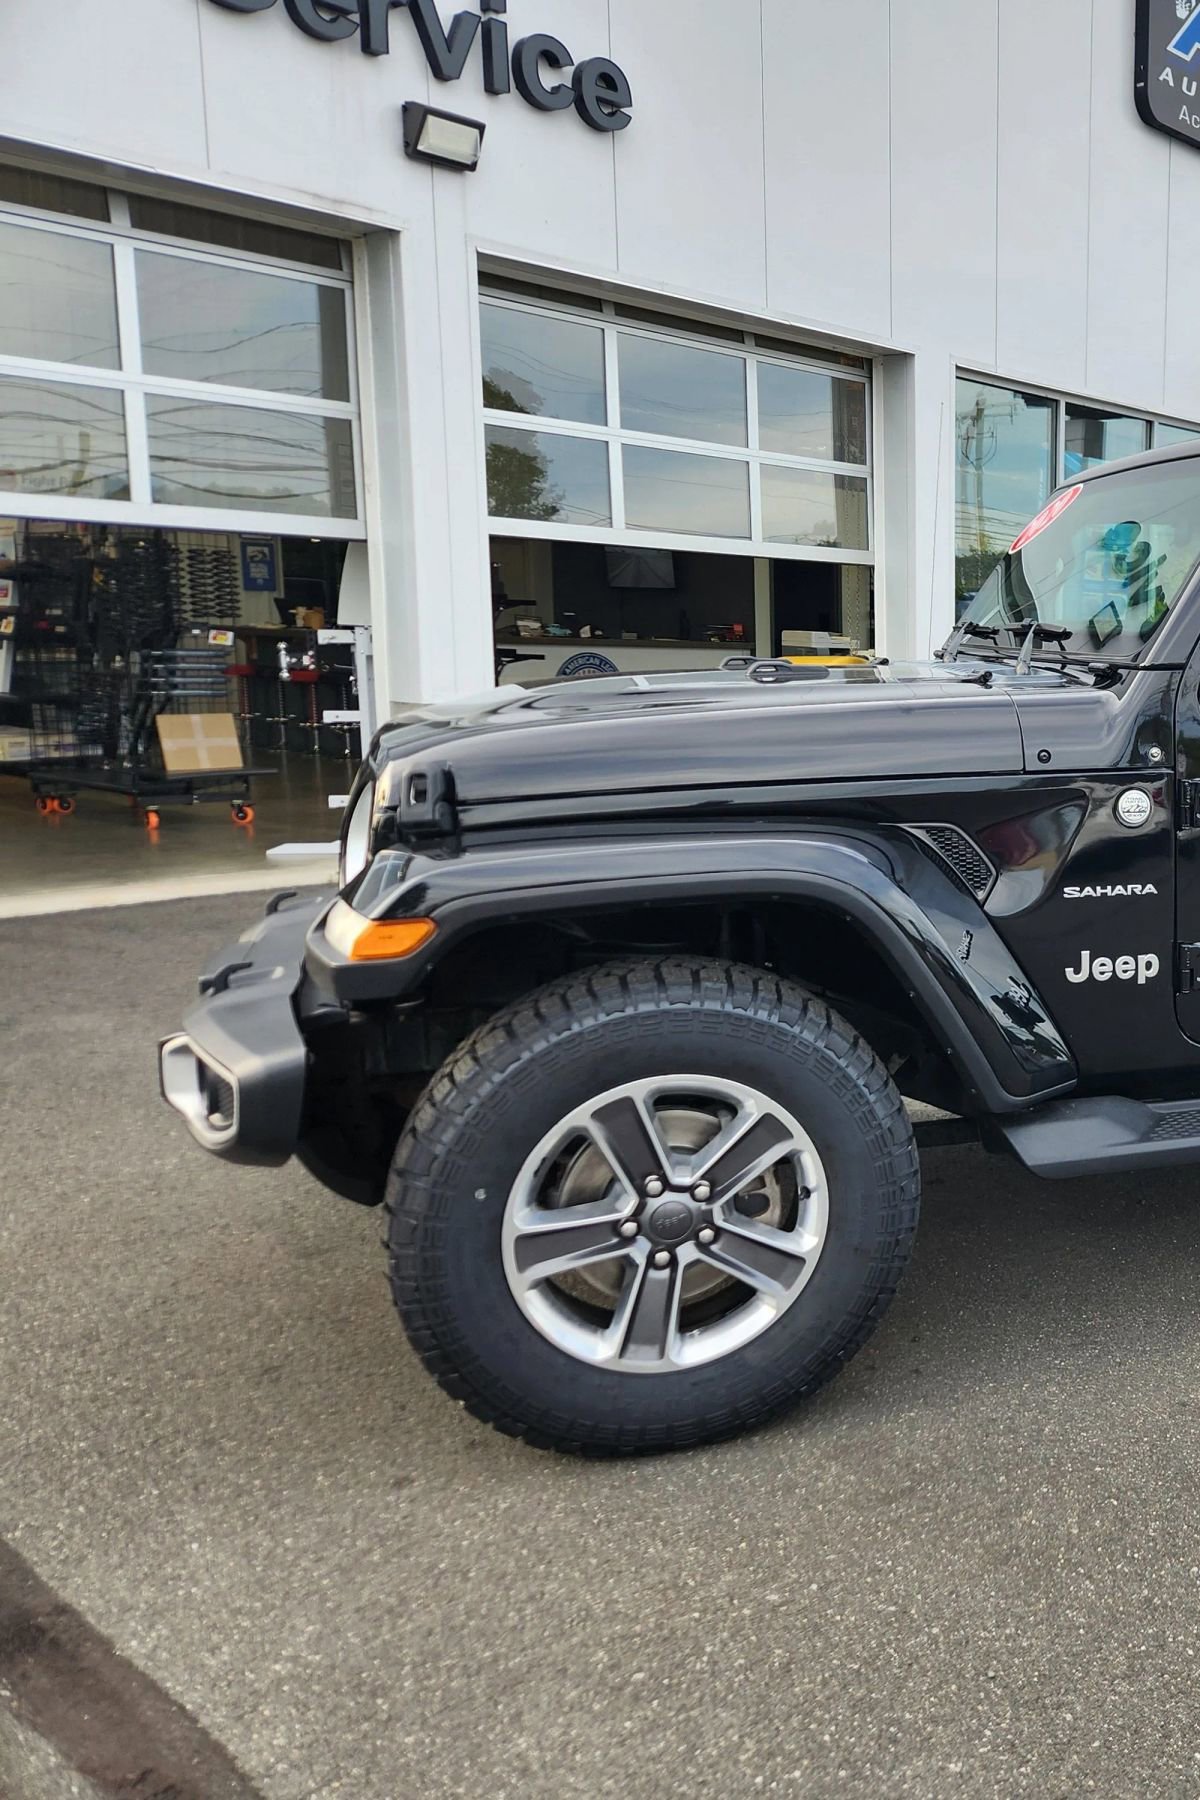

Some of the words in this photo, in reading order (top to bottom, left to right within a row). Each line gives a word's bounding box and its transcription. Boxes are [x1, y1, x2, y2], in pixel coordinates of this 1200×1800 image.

[207, 0, 632, 132] ervice
[1063, 883, 1158, 898] SAHARA
[1065, 950, 1160, 984] Jeep
